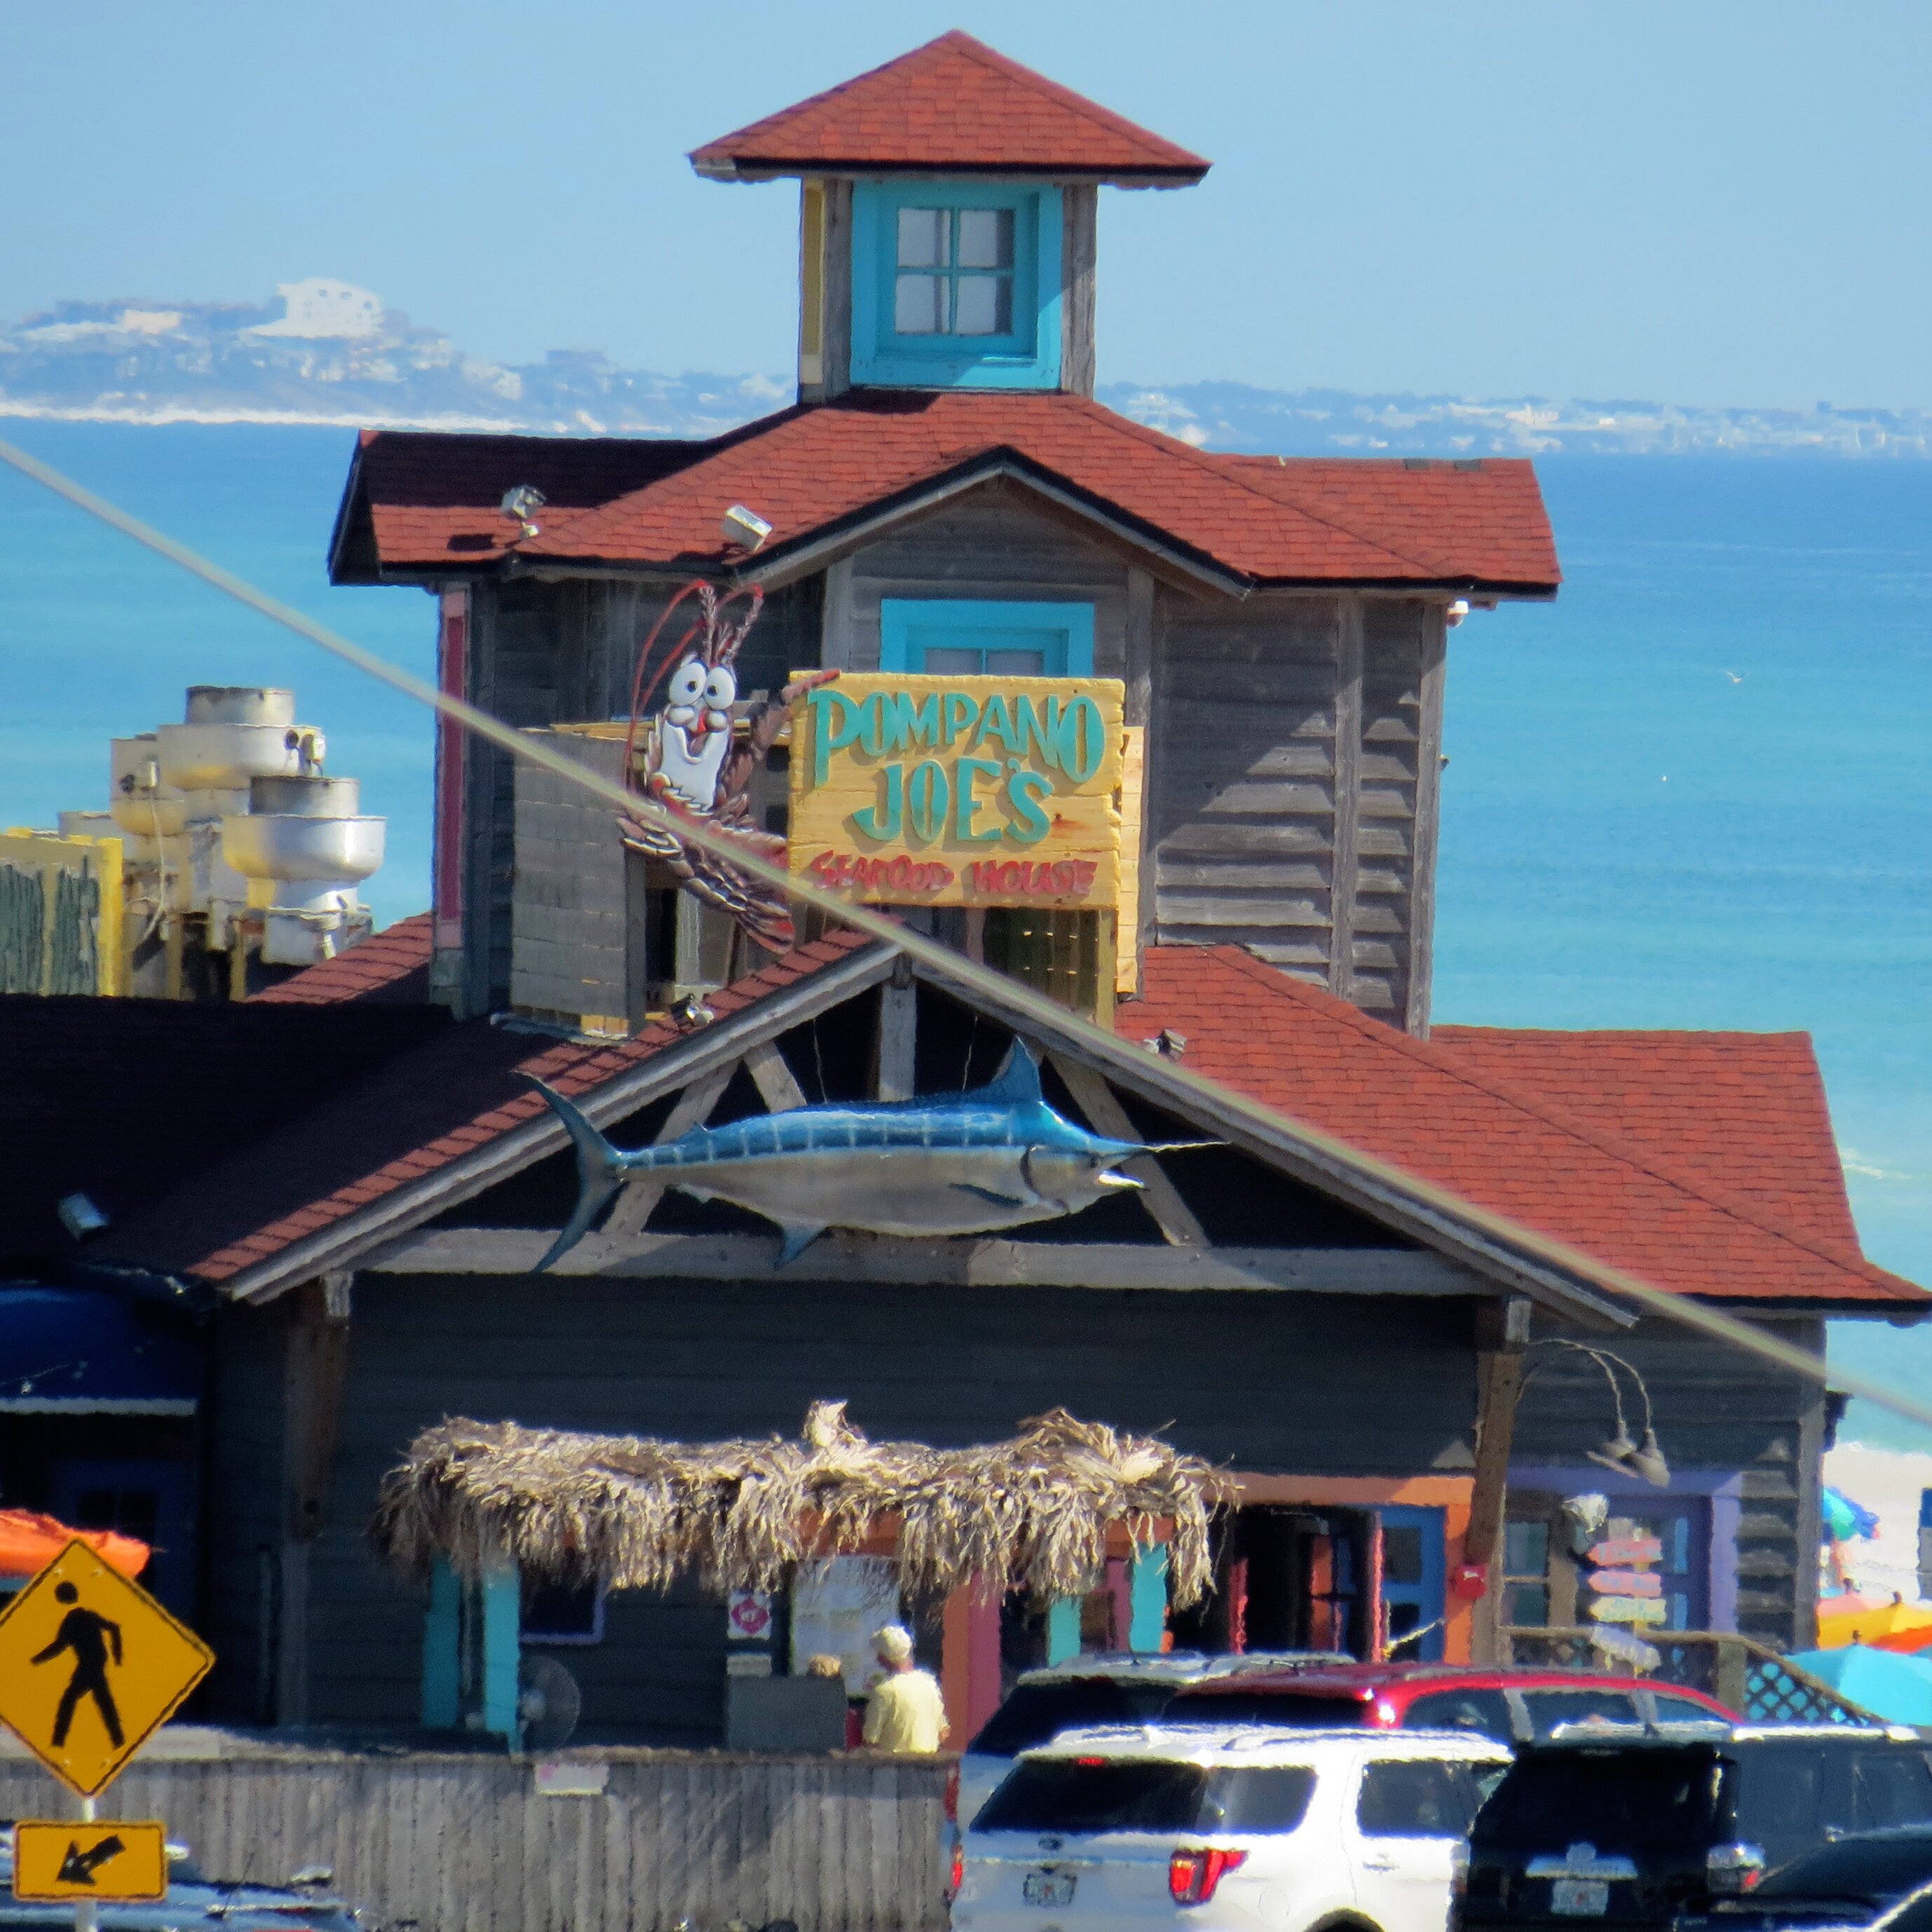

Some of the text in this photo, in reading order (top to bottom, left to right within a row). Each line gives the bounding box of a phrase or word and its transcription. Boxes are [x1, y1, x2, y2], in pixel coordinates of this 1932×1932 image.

[807, 690, 1105, 787] POMPANO
[852, 757, 1054, 843] JOE'S
[810, 850, 1098, 897] SEAFOOD HOUSE
